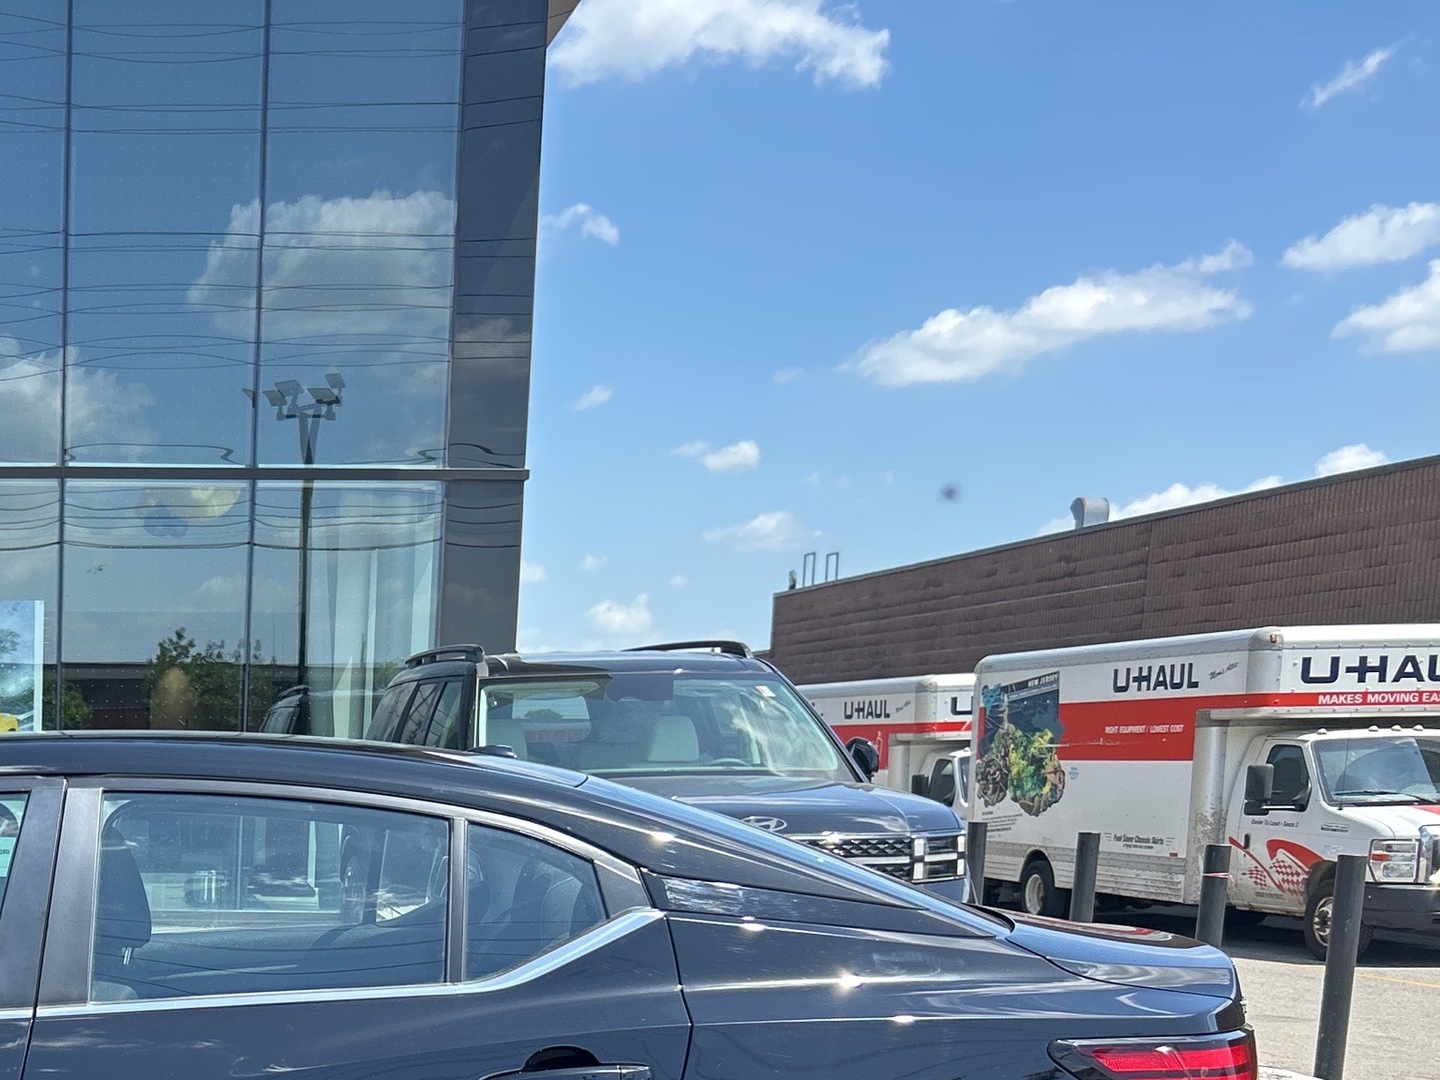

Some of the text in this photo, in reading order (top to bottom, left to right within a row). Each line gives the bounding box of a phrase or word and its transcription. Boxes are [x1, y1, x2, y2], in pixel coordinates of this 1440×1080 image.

[1113, 662, 1200, 694] U-HAUL
[1318, 692, 1440, 705] MAKES MOVING EA
[844, 700, 891, 719] U-HAUL
